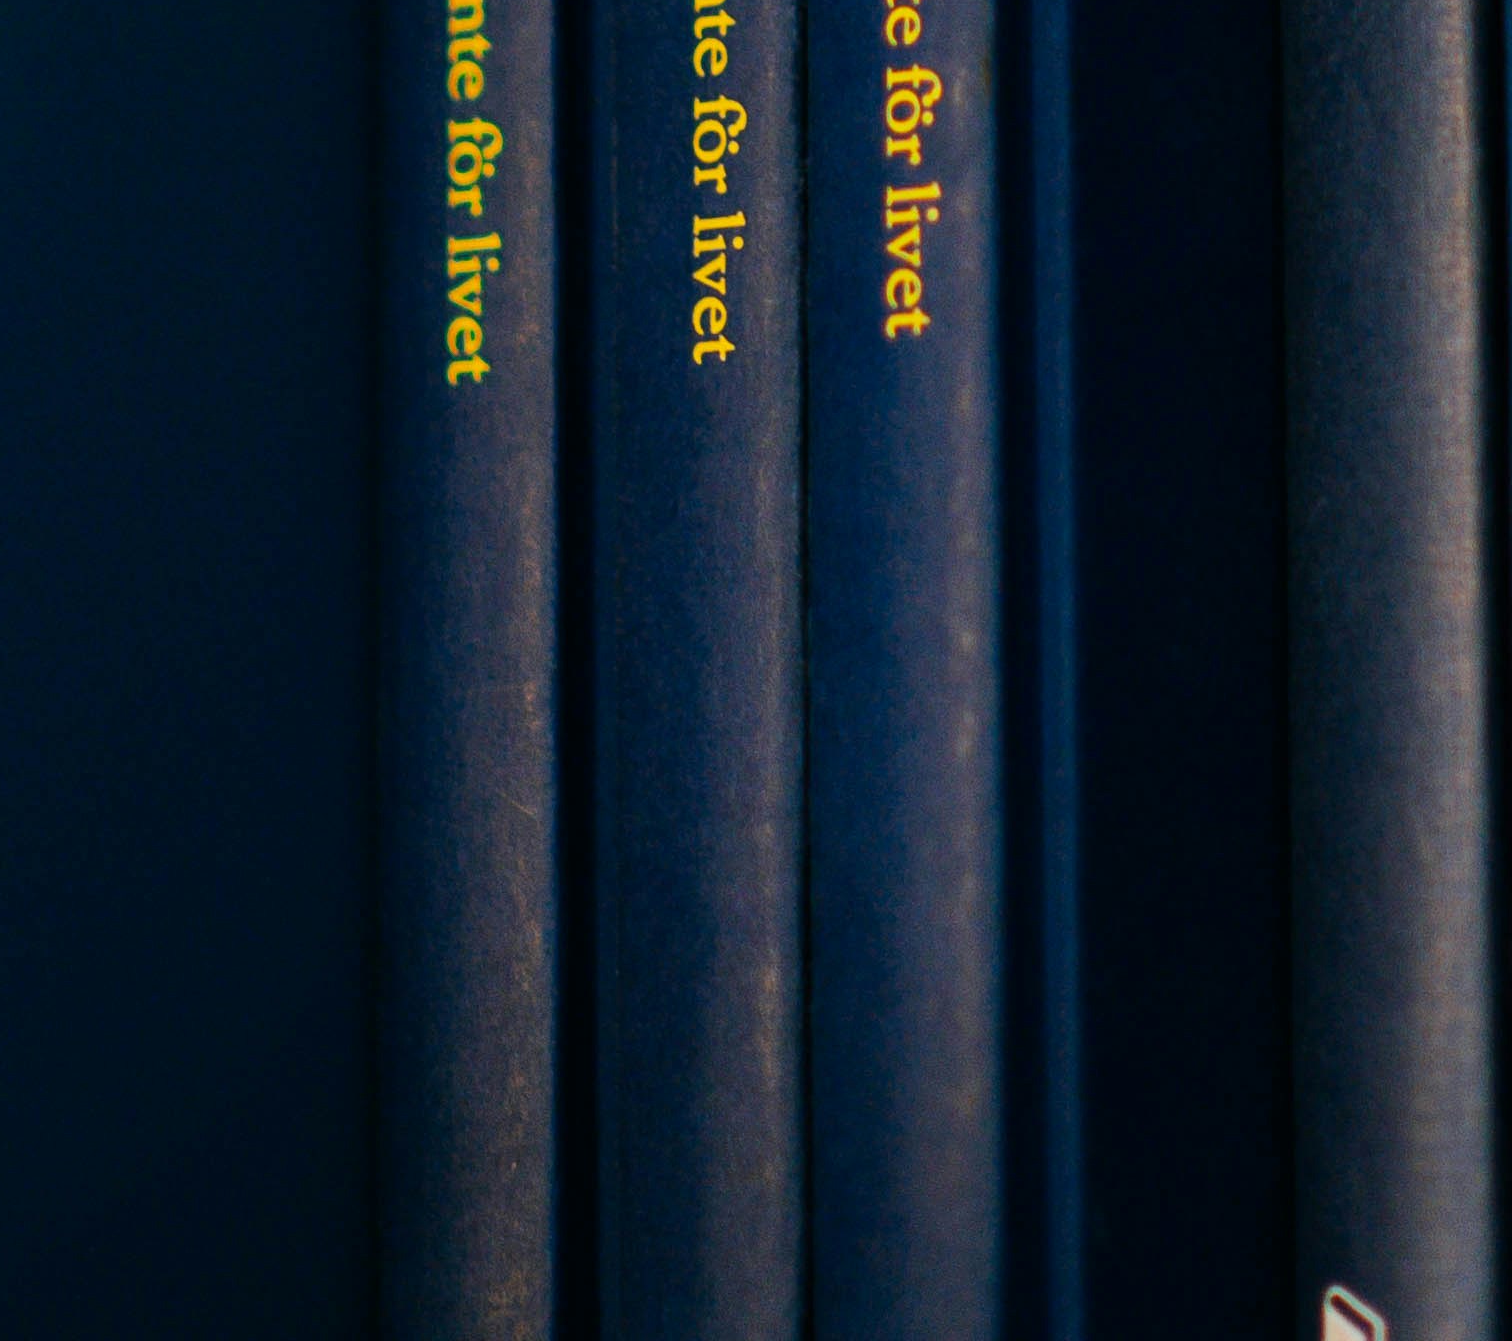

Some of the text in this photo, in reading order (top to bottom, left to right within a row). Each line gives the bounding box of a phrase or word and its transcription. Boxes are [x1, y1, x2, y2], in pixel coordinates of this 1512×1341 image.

[449, 119, 503, 216] för
[693, 96, 747, 194] för
[885, 65, 943, 165] för
[448, 233, 501, 384] livet
[693, 213, 746, 364] livet
[885, 182, 942, 336] livet
